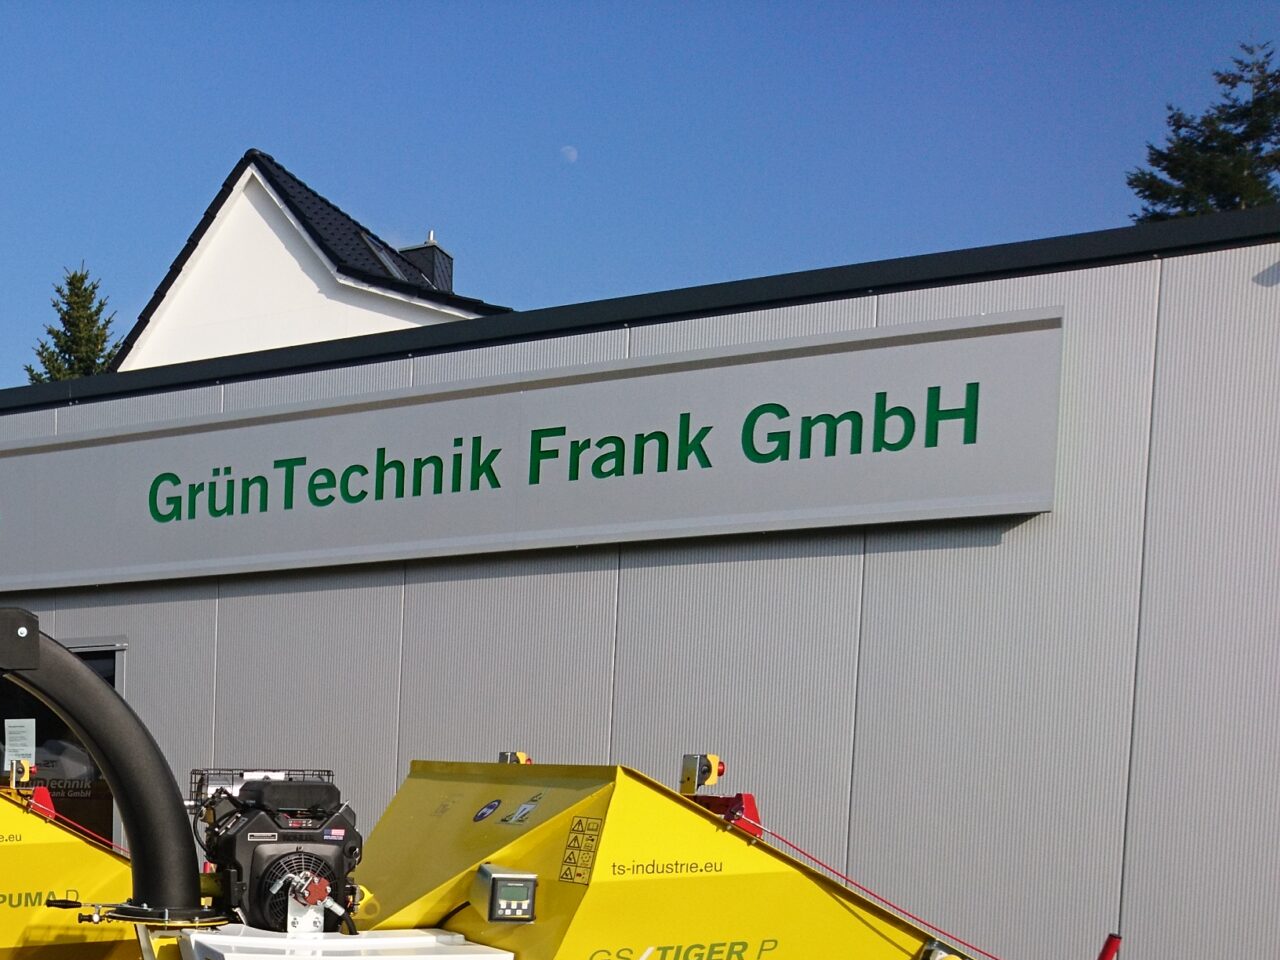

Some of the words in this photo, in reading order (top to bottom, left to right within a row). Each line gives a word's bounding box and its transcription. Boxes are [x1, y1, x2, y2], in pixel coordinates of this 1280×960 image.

[148, 436, 502, 524] GrünTechnik
[528, 412, 713, 485] Frank
[741, 382, 980, 464] GmbH
[612, 859, 723, 875] ts-industrie.eu
[756, 939, 778, 960] P
